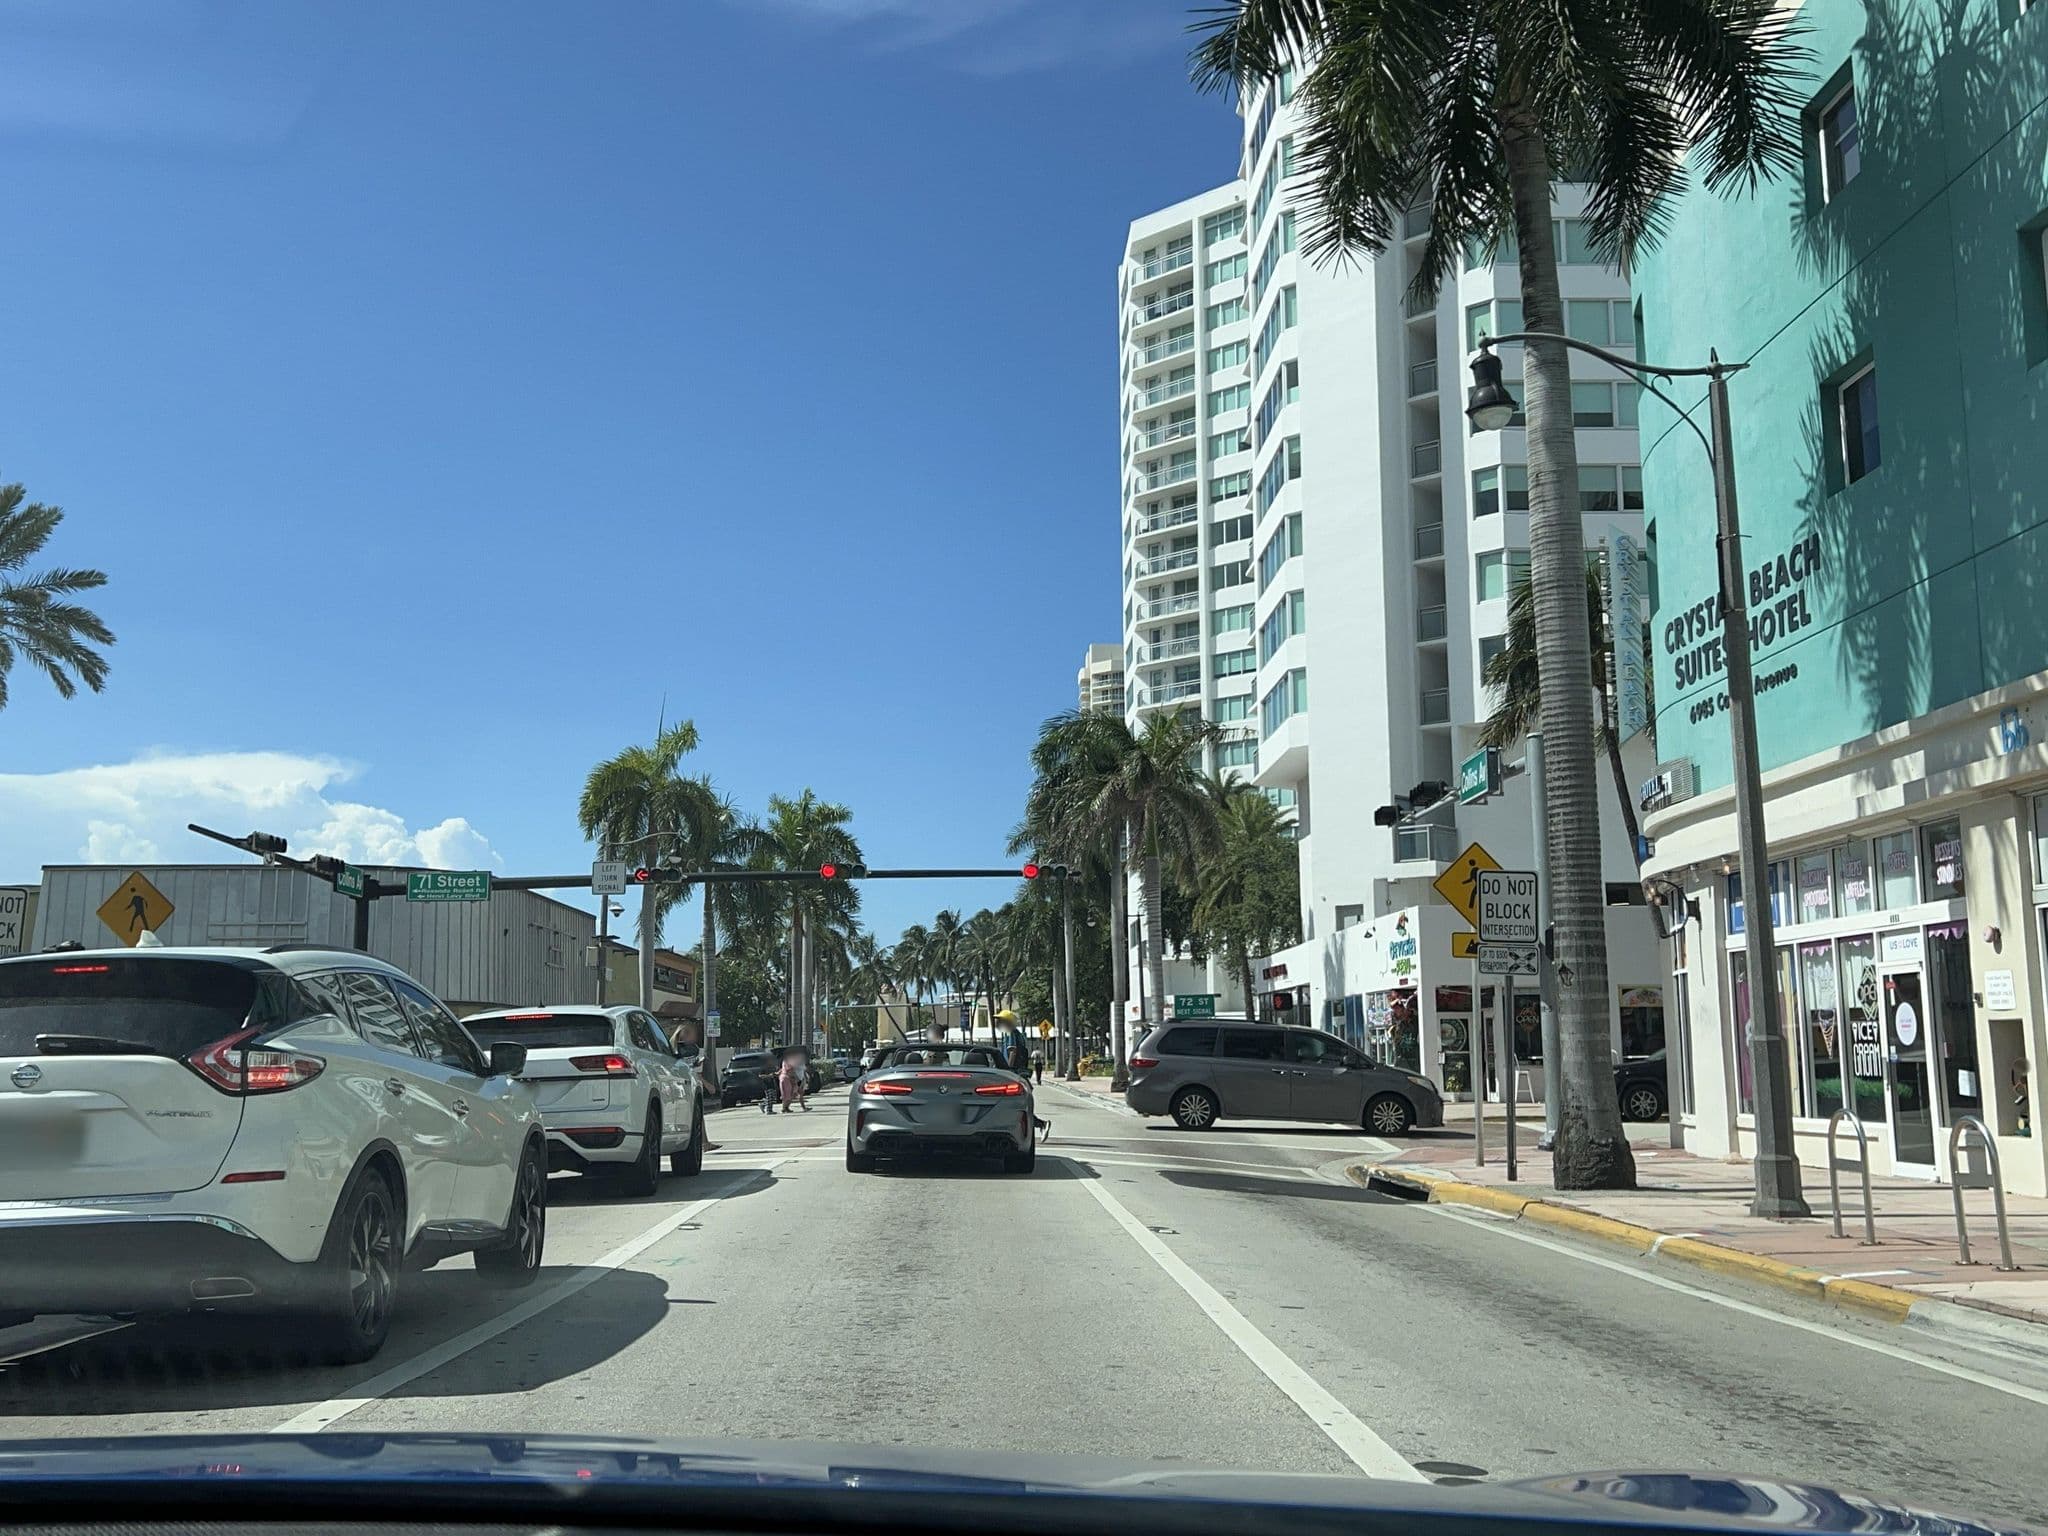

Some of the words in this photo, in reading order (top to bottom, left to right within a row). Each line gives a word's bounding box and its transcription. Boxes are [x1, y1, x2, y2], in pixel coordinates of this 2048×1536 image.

[1665, 592, 1725, 654] CRYSTA
[1749, 532, 1821, 608] BEACH
[1674, 633, 1728, 690] SUITES
[1746, 588, 1812, 652] HOTEL
[1689, 696, 1715, 725] 6985
[1754, 662, 1799, 697] Avenue
[417, 874, 432, 889] 71
[437, 875, 481, 888] Street
[1482, 879, 1501, 895] DO
[1507, 879, 1534, 896] NOT
[1486, 902, 1531, 920] BLOCK
[1482, 923, 1535, 937] INTERSECTION
[1903, 937, 1918, 949] LOVE
[1179, 998, 1194, 1006] 72
[1198, 997, 1209, 1006] ST
[1858, 983, 1877, 1002] OPE
[1858, 1022, 1874, 1041] ICE
[1853, 1042, 1883, 1078] CREAM
